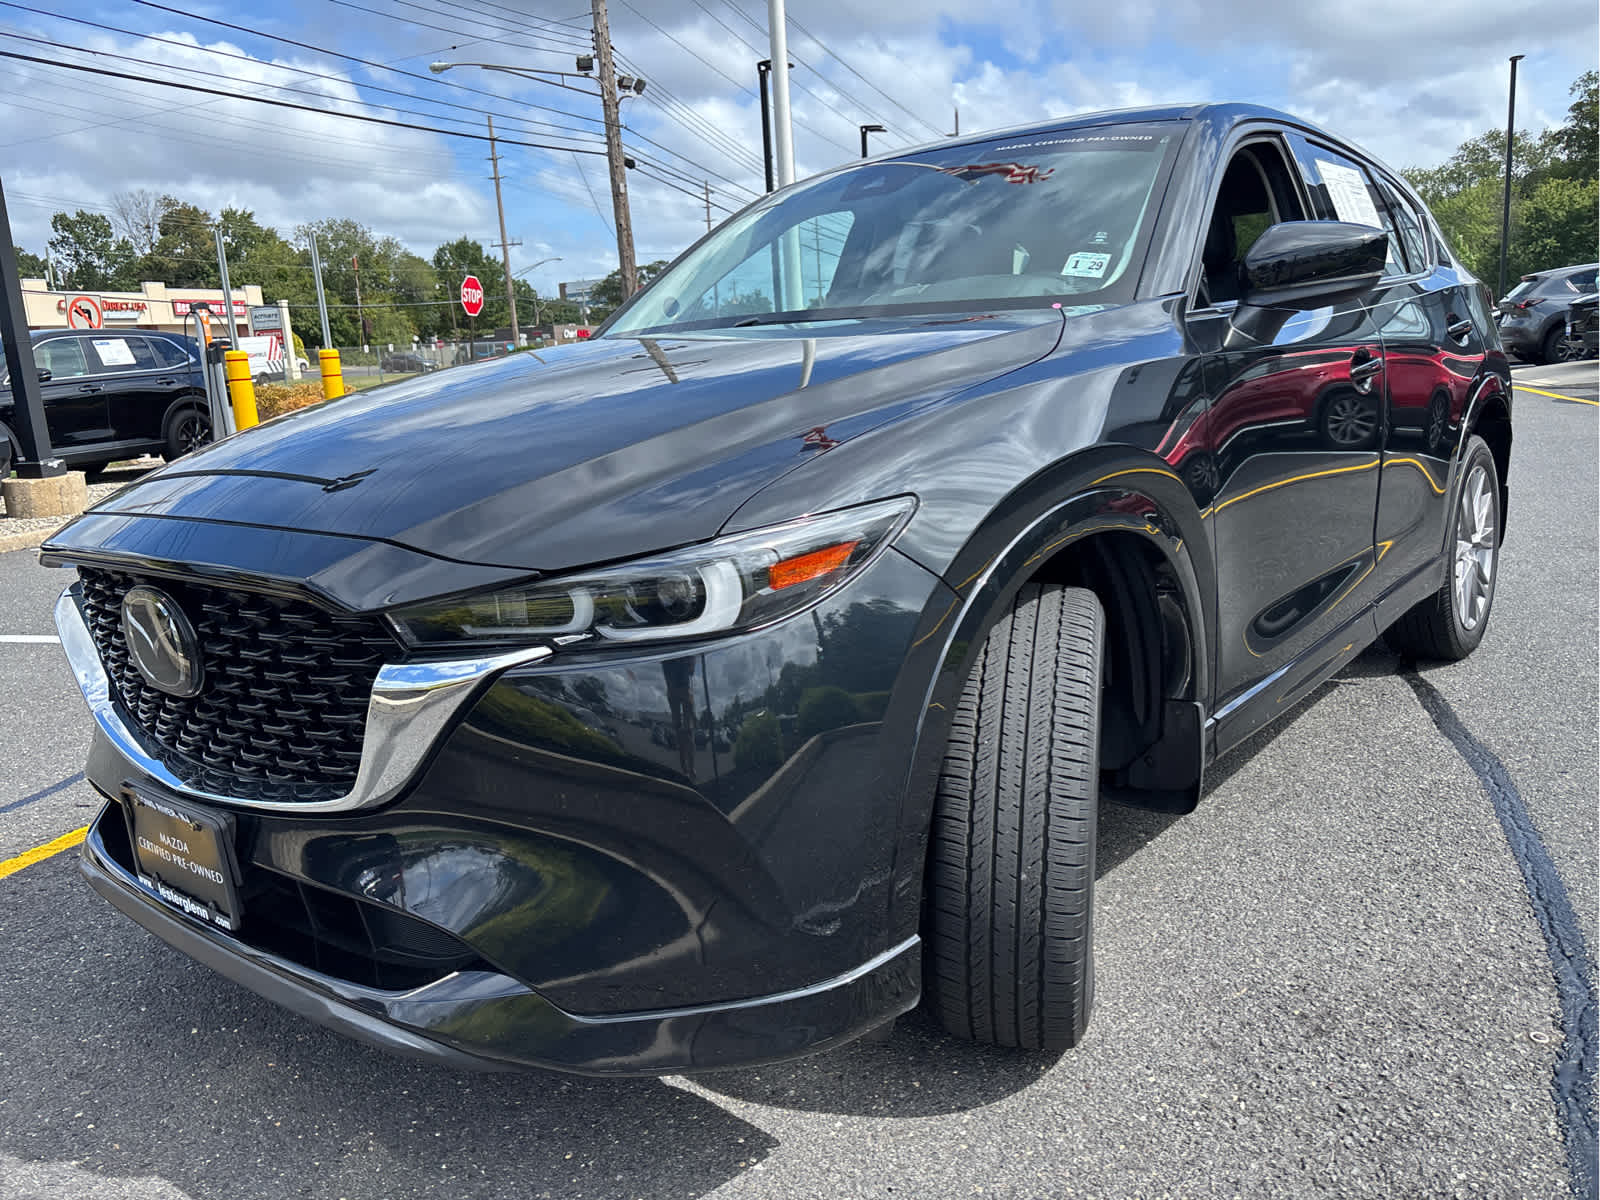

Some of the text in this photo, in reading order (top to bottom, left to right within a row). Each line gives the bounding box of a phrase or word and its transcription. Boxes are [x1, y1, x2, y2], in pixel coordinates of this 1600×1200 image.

[994, 143, 1032, 151] MAZDA
[1035, 137, 1085, 147] CERTIFIED
[1071, 260, 1103, 270] 1 29
[463, 287, 482, 304] STOP
[160, 832, 190, 855] MAZDA
[138, 836, 224, 884] CERTIFIED PRE-OWNED
